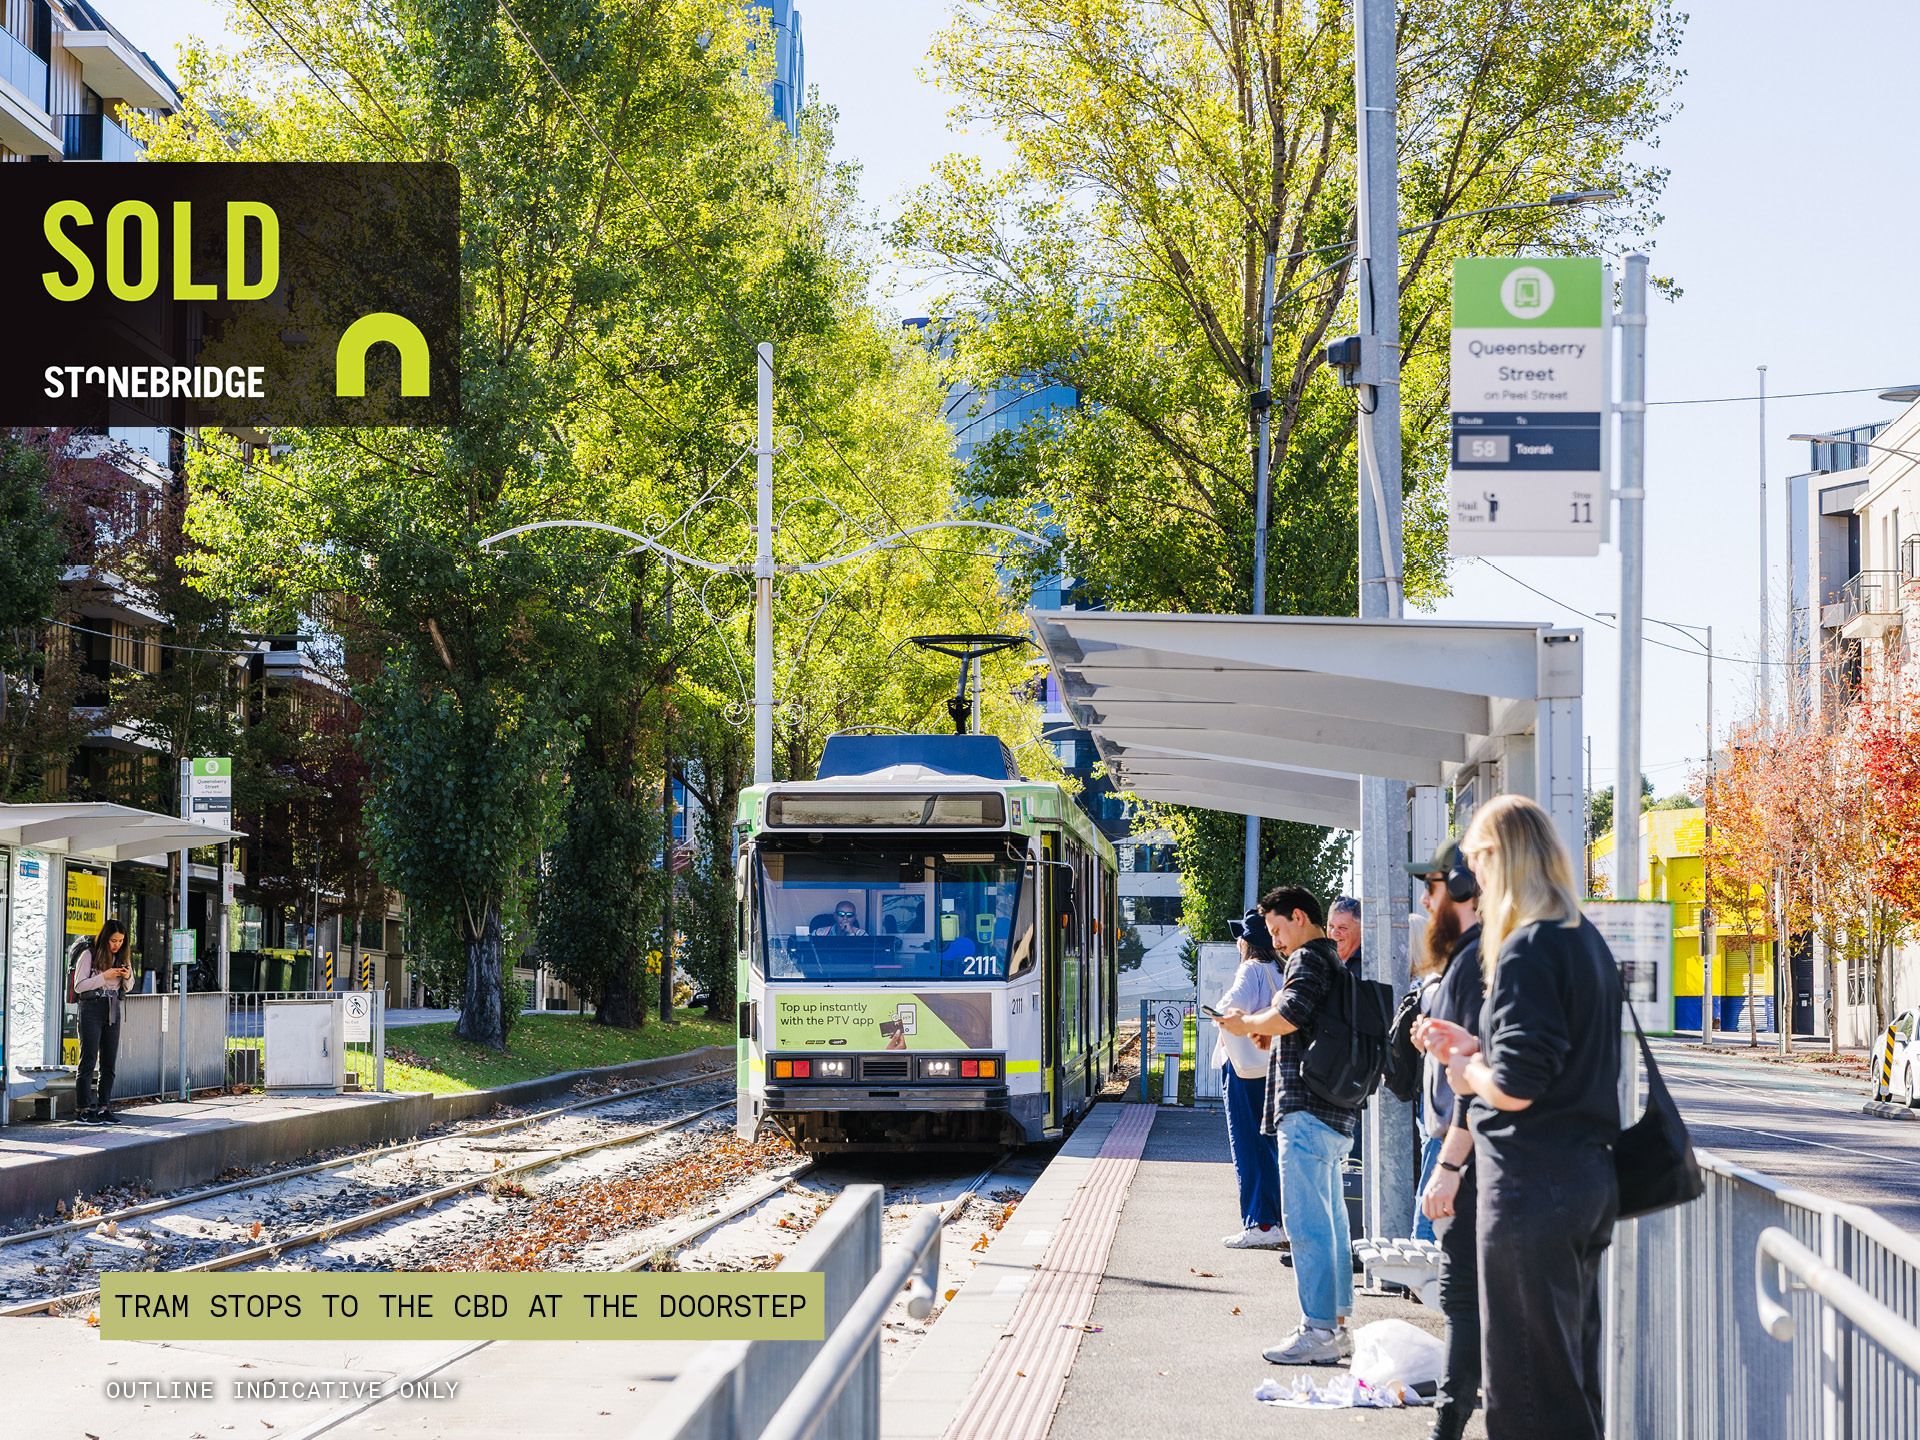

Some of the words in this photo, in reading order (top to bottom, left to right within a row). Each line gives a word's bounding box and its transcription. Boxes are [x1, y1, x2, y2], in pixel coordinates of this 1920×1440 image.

[1468, 340, 1585, 359] Queensberry
[1498, 366, 1555, 381] Street
[1484, 392, 1499, 400] on
[1502, 390, 1527, 400] Peel
[1530, 390, 1569, 400] Street
[1457, 416, 1484, 425] Route
[1516, 416, 1528, 425] To
[1471, 440, 1497, 457] 58
[1515, 443, 1554, 455] Toorak
[1571, 490, 1592, 500] Stop
[1457, 500, 1478, 511] Hail
[1457, 512, 1485, 523] Tram
[1571, 502, 1592, 523] 11
[963, 955, 997, 976] 2111
[780, 1002, 801, 1013] Top
[803, 1004, 818, 1013] up
[819, 1002, 868, 1014] instantly
[1011, 997, 1023, 1015] 2111
[780, 1015, 804, 1026] with
[806, 1016, 825, 1026] the
[827, 1016, 850, 1025] PTV
[852, 1017, 875, 1027] app
